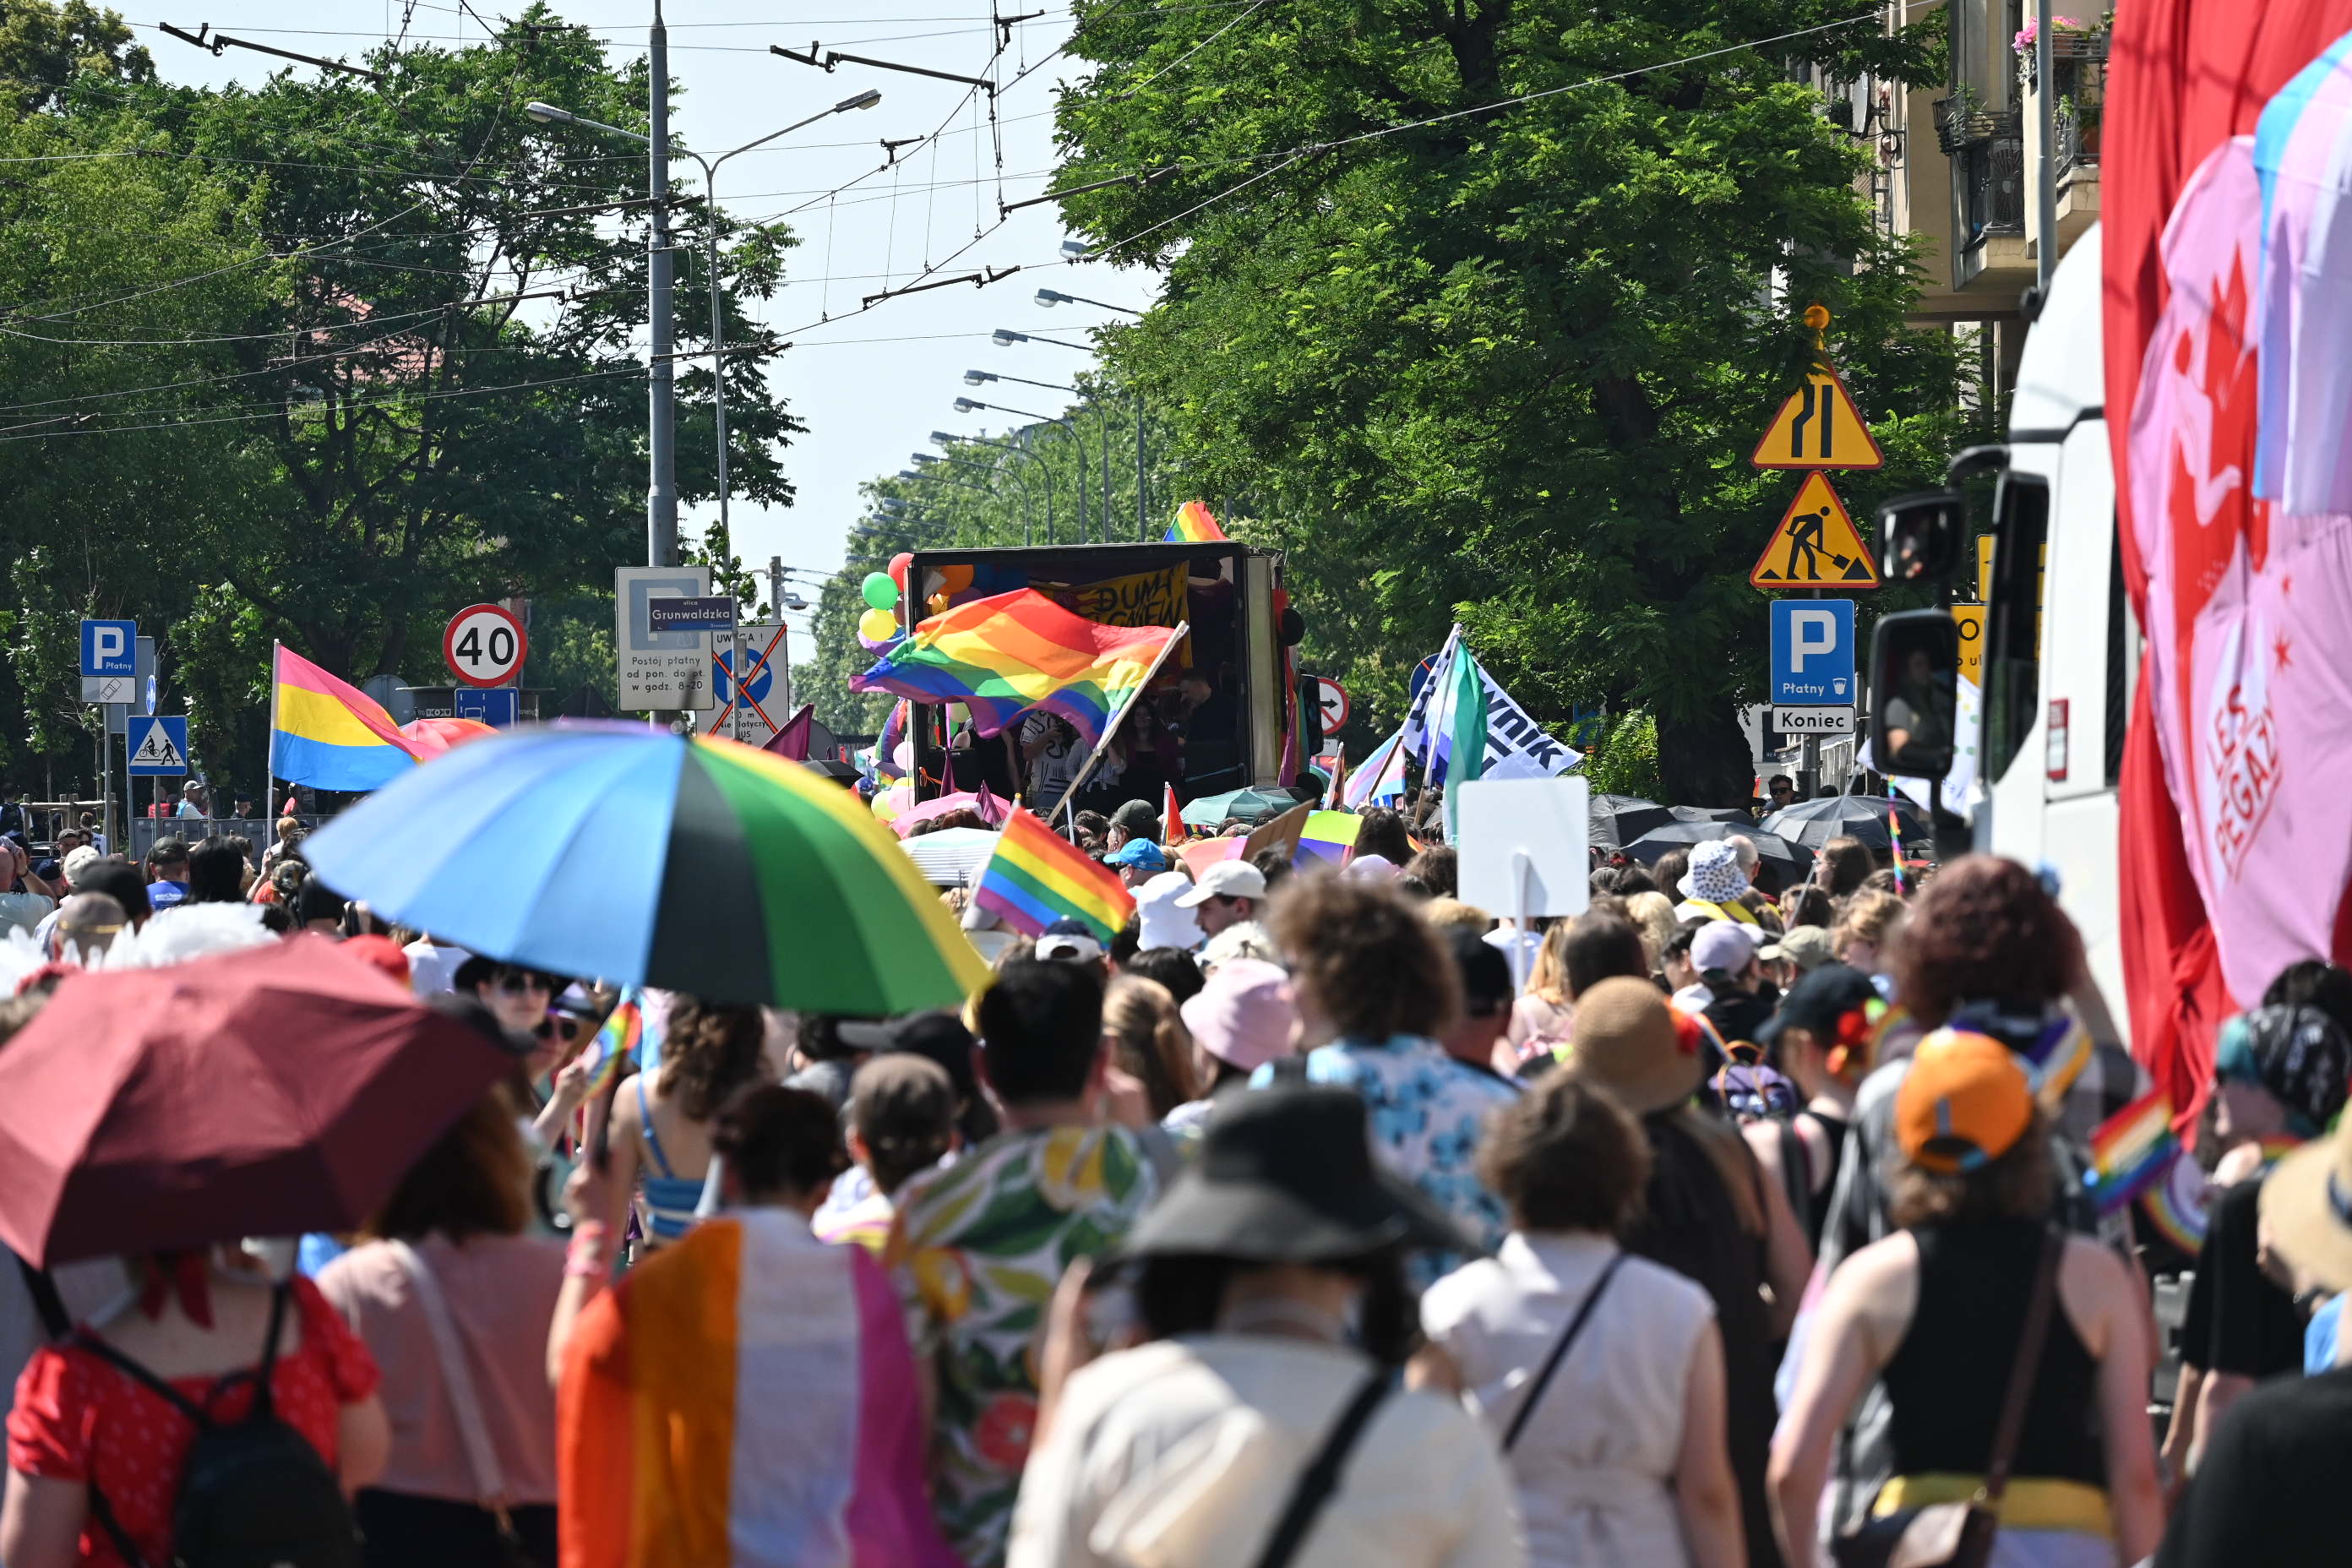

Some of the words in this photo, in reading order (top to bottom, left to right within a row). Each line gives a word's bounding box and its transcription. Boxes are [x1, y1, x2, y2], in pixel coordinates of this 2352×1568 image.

[652, 608, 730, 620] Grunwaldzka
[716, 633, 754, 643] UWA
[1790, 609, 1837, 672] P
[94, 626, 124, 669] P
[455, 627, 514, 666] 40
[106, 662, 132, 672] Płatny
[632, 656, 662, 667] Postój
[667, 656, 700, 667] płatny
[627, 669, 640, 678] od
[645, 671, 667, 680] pon.
[673, 669, 686, 678] do
[645, 682, 672, 693] godz.
[678, 680, 703, 690] 8-20
[1783, 683, 1825, 697] Płatny
[1782, 712, 1844, 727] Koniec
